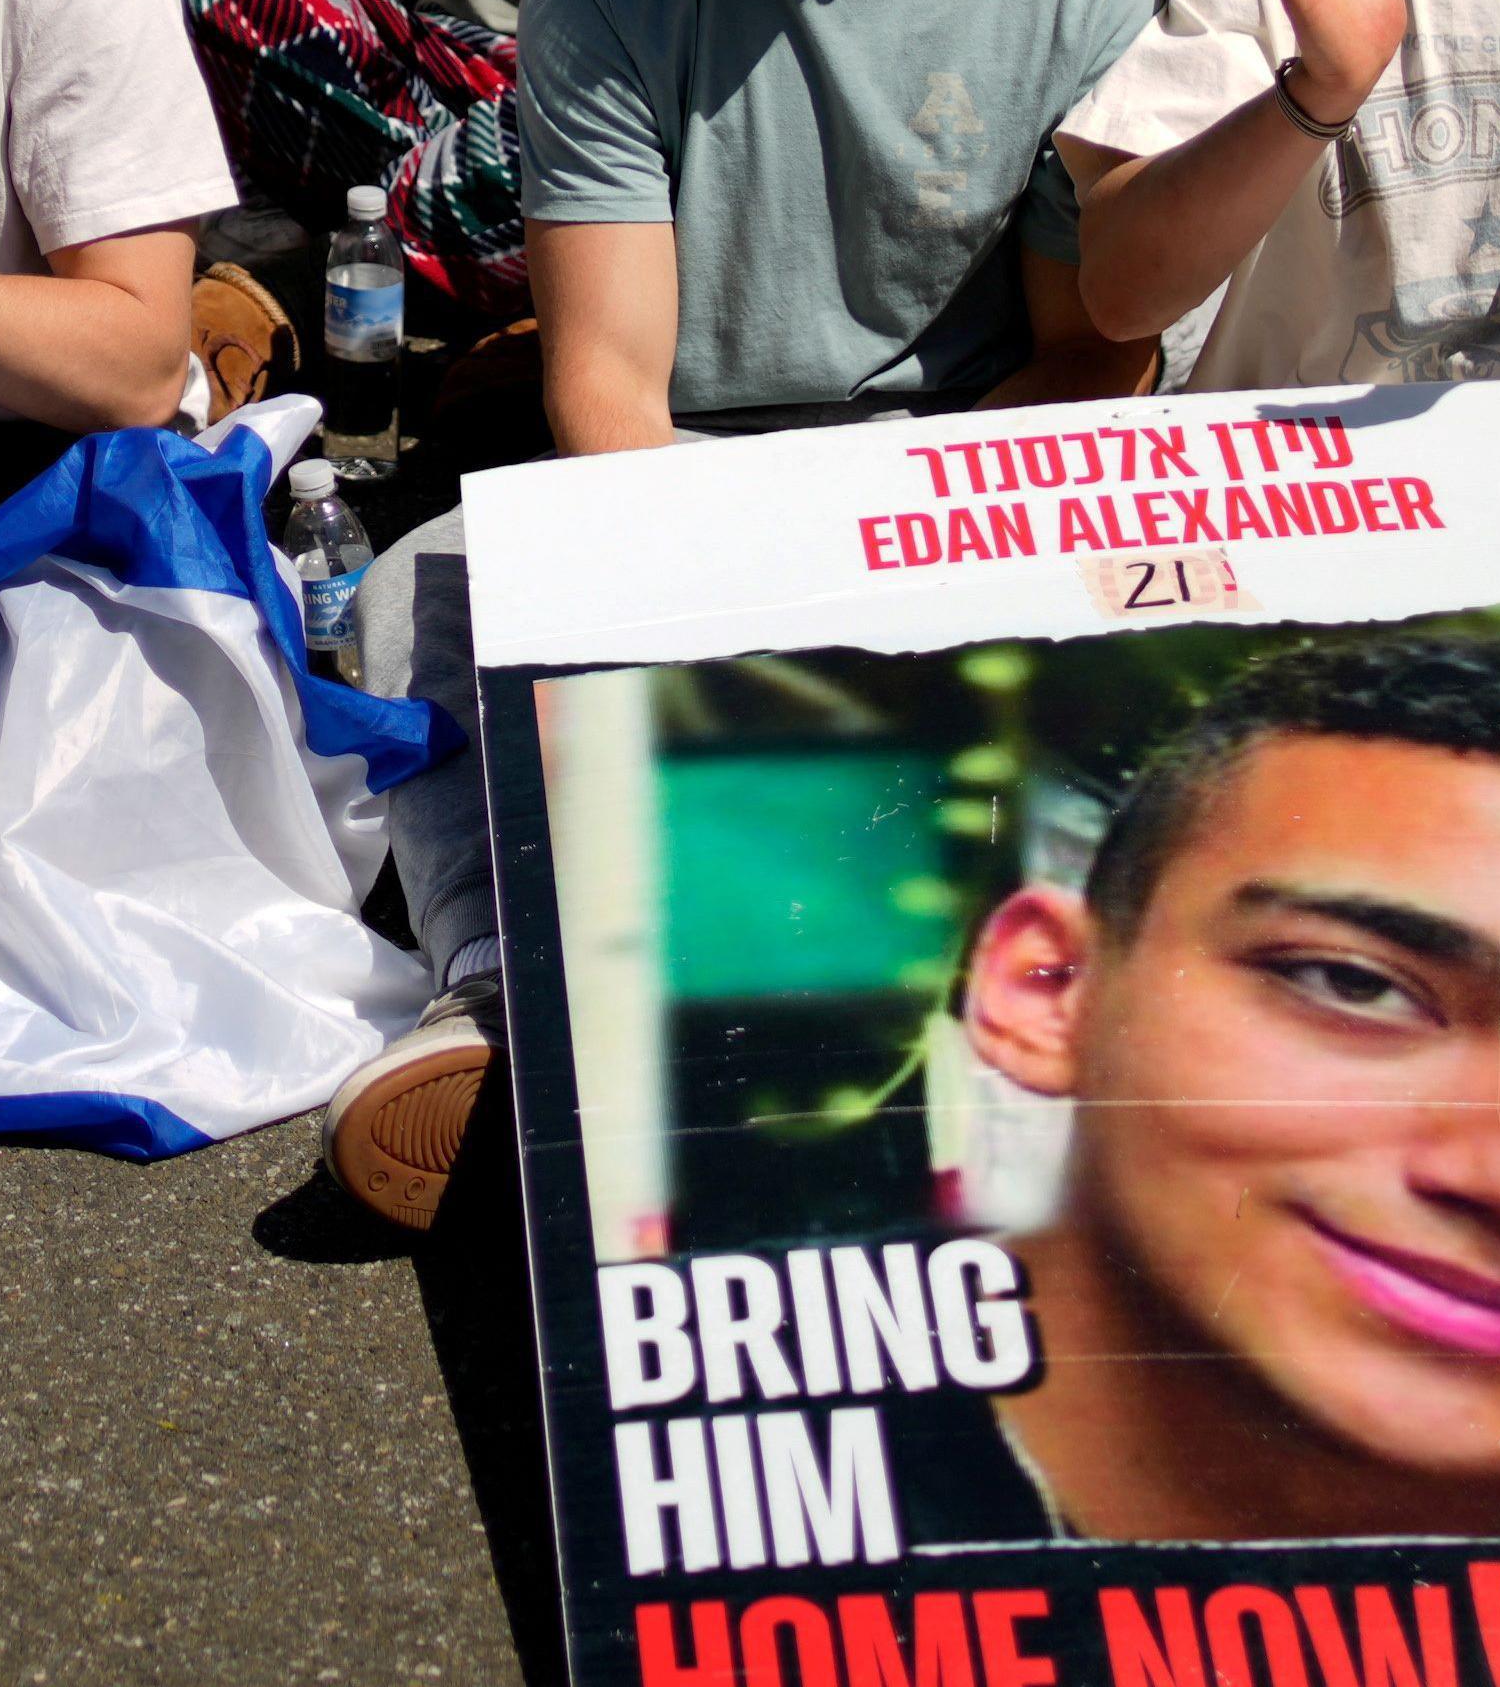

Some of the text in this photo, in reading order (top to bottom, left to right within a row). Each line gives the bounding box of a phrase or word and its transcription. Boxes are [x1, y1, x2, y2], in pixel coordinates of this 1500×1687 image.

[908, 72, 985, 135] A
[906, 416, 1355, 500] עידן אלכסנדר
[858, 477, 1446, 572] EDAN ALEXANDER
[1124, 560, 1191, 609] 21
[596, 1239, 1032, 1411] BRING
[614, 1406, 903, 1578] HIM
[635, 1589, 1058, 1687] HOME
